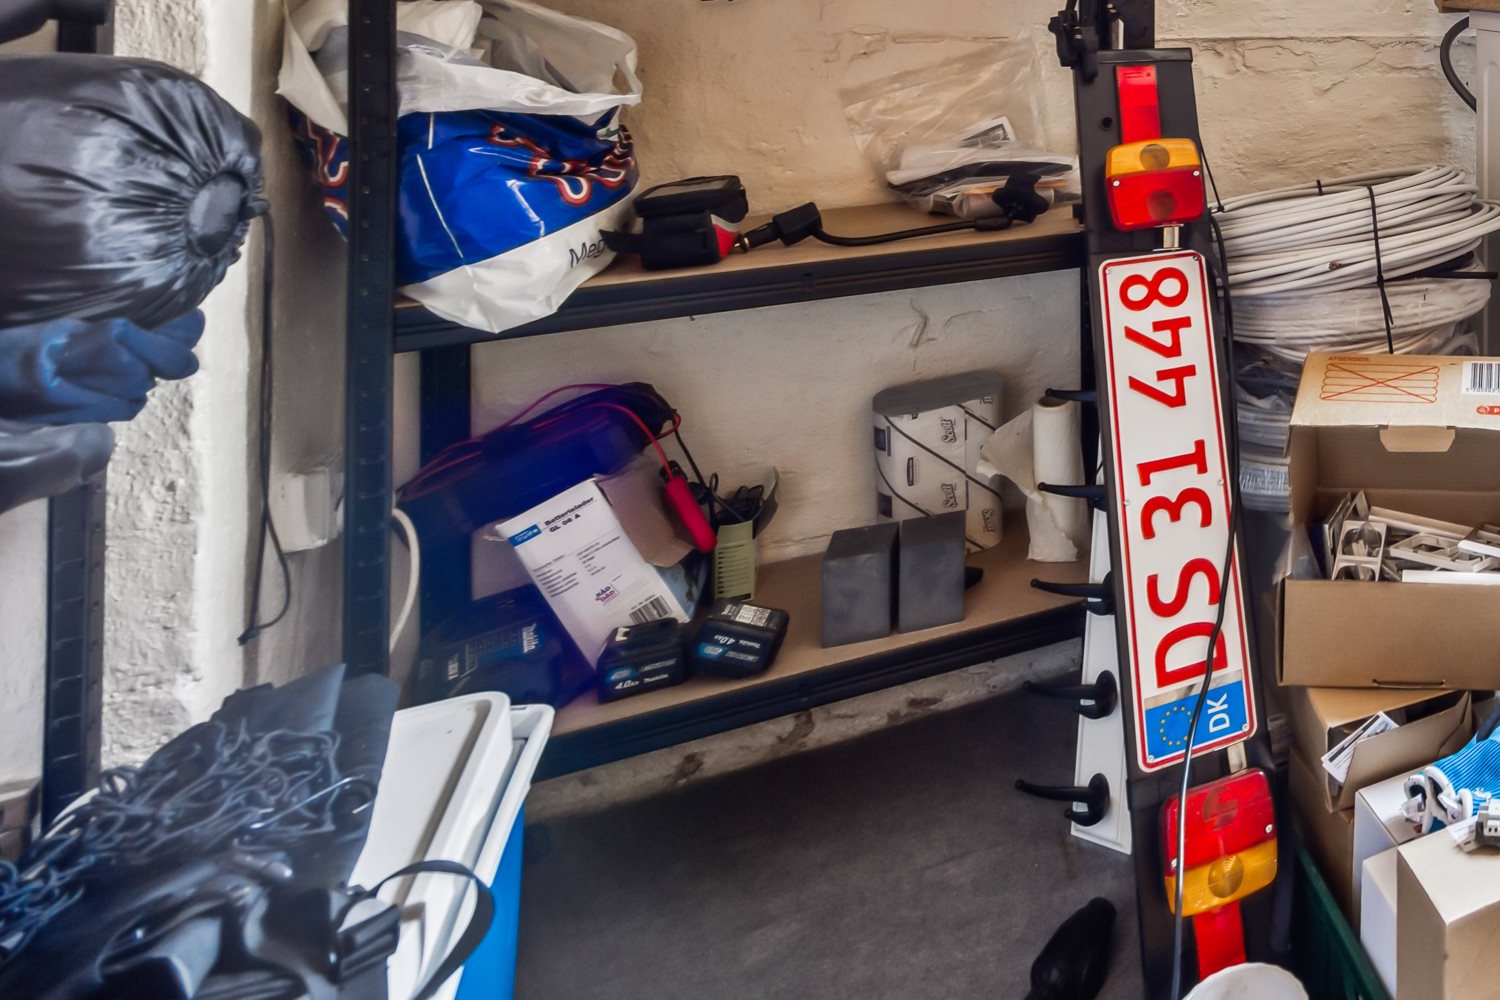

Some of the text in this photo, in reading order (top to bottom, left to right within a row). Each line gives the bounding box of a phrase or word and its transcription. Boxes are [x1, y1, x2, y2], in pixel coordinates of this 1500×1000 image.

[1118, 266, 1228, 689] DS 31 448
[1209, 693, 1229, 734] DK
